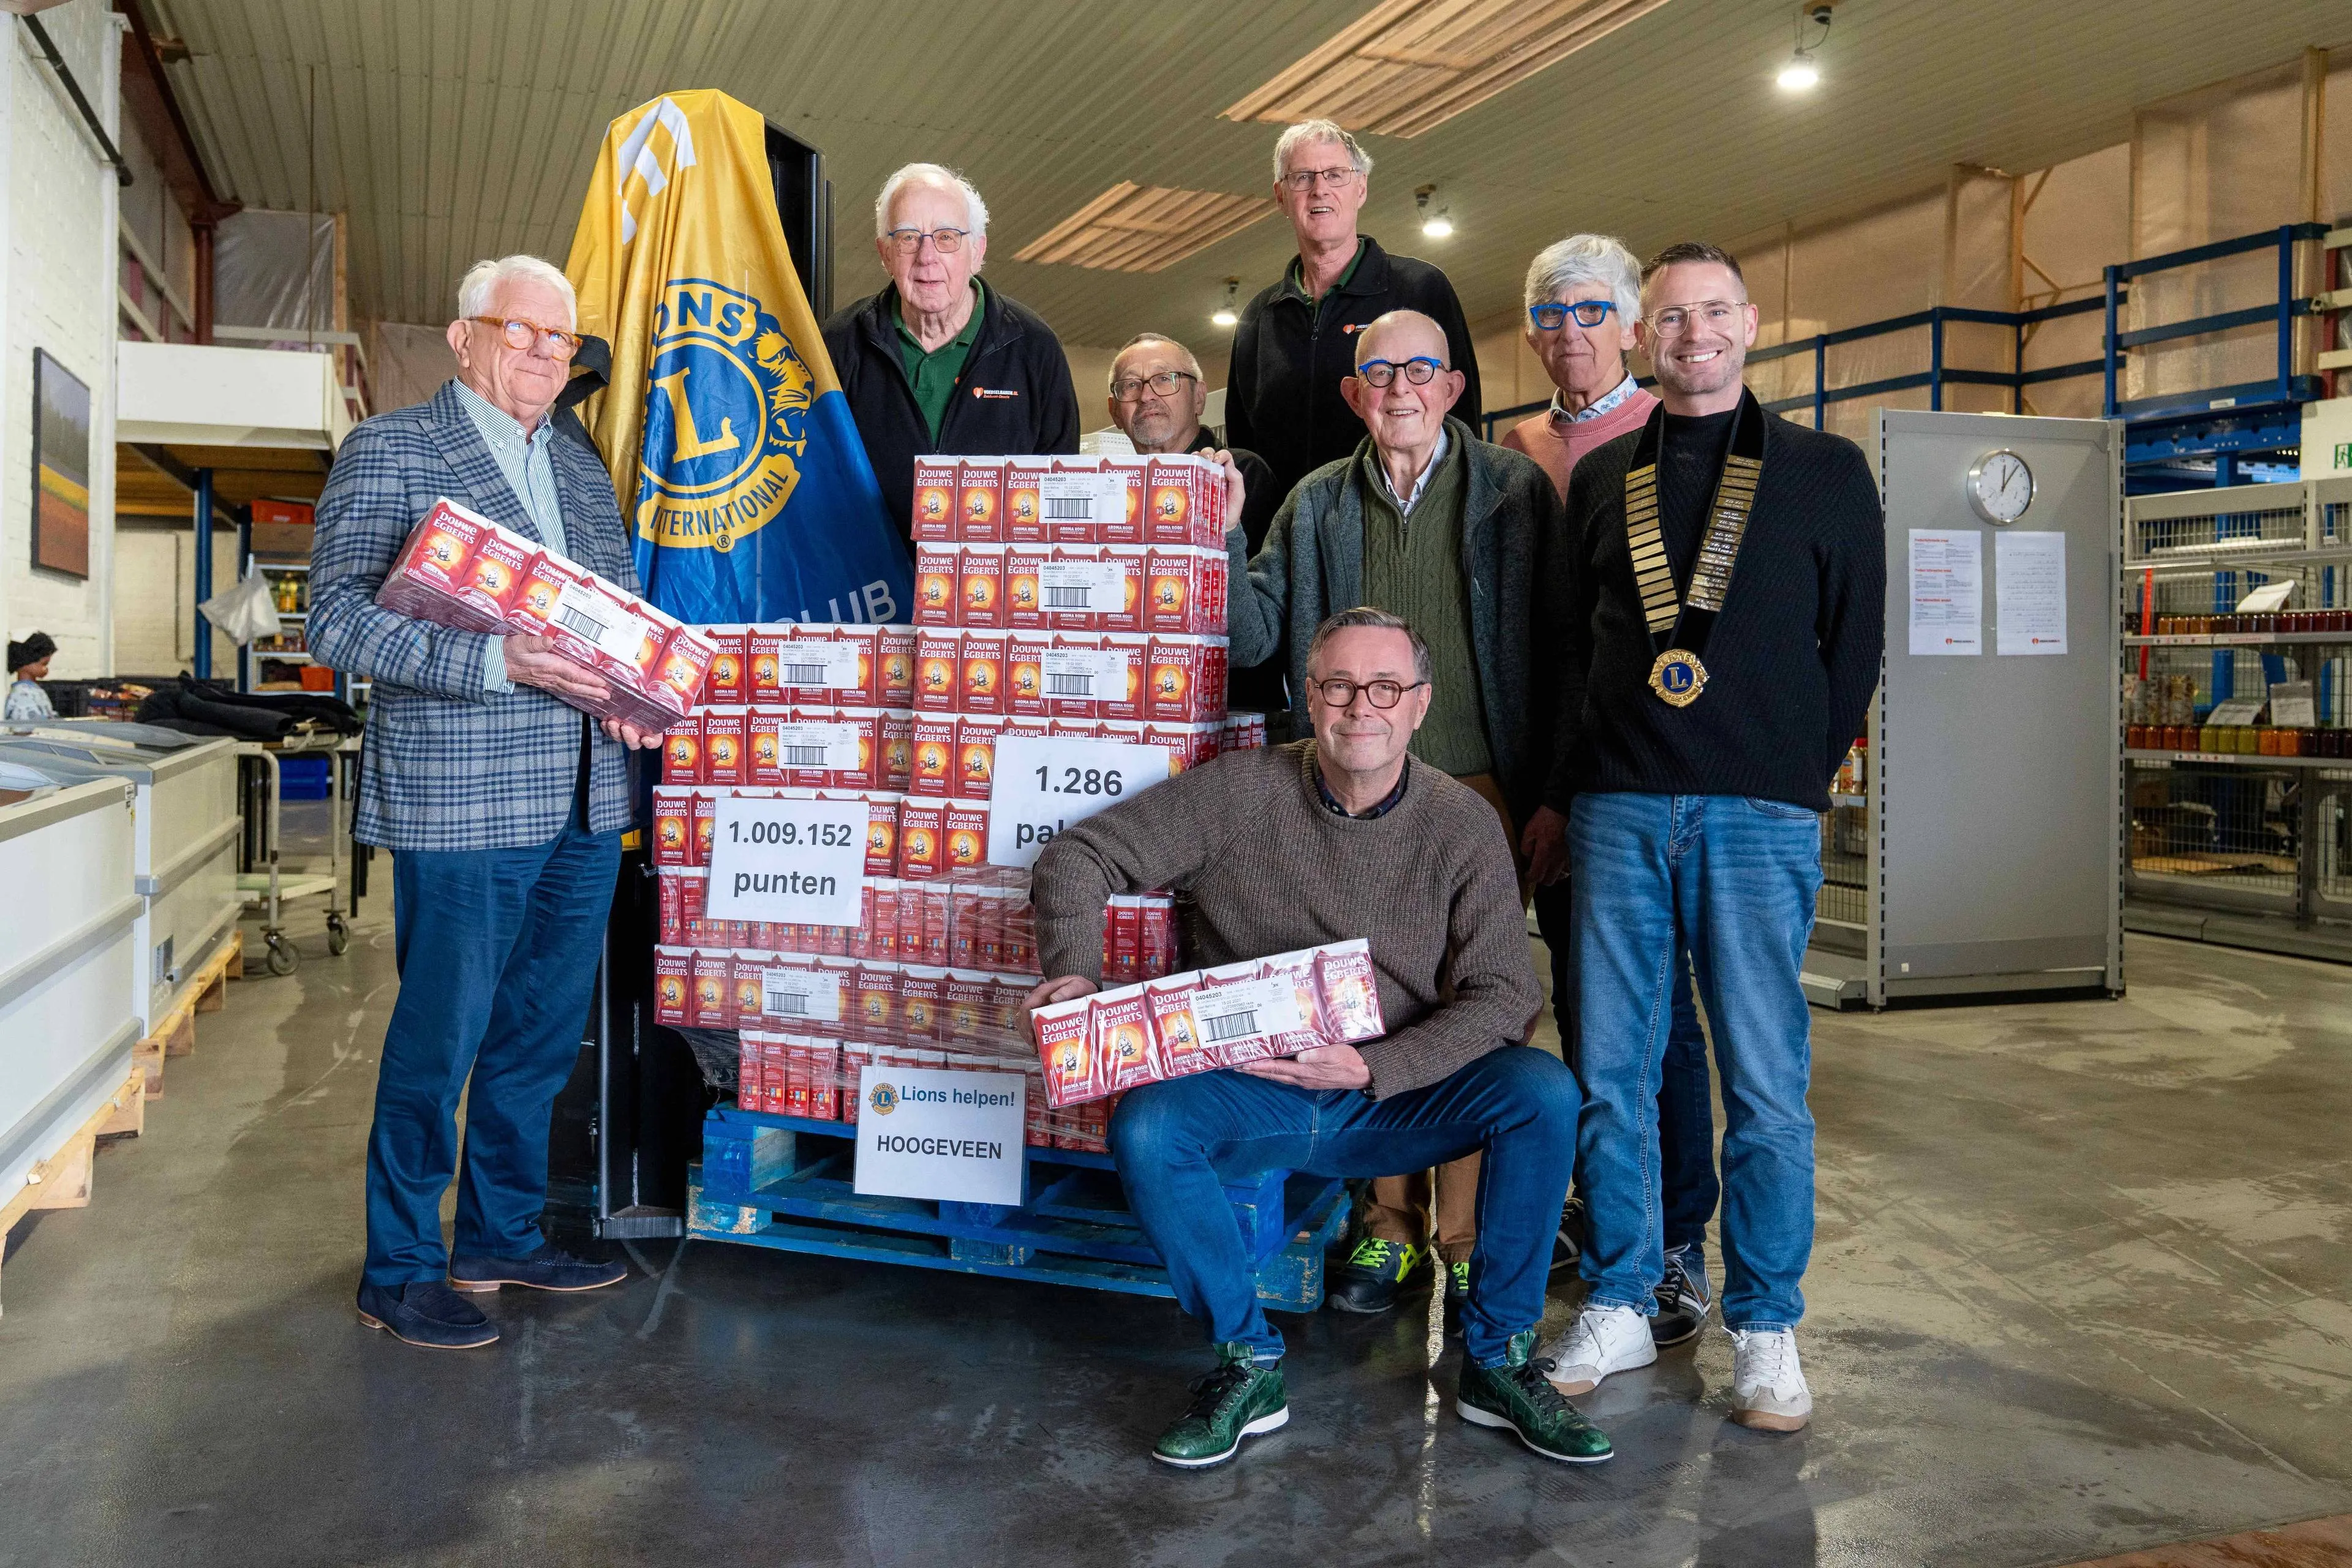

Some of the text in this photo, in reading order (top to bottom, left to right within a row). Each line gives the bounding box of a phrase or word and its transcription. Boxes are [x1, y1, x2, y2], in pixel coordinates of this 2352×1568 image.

[656, 292, 747, 337] ONS
[655, 367, 740, 464] L
[1152, 478, 1190, 486] EGBERTS
[433, 520, 475, 545] EGBERTS
[482, 546, 522, 571] EGBERTS
[532, 569, 564, 589] EGBERT
[569, 584, 592, 599] 04045203
[671, 643, 706, 668] EGBERTS
[881, 645, 916, 654] EGBERTS
[920, 649, 956, 658] EGBERTS
[964, 650, 1000, 659] EGBERTS
[1152, 655, 1190, 665] EGBERTS
[1668, 667, 1688, 689] L
[883, 730, 912, 739] EGBERT
[915, 733, 951, 742] EGBERTS
[1036, 765, 1123, 796] 1.286
[903, 819, 938, 829] EGBERTS
[947, 821, 983, 831] EGBERTS
[729, 821, 851, 847] 1.009.152
[734, 870, 836, 898] punten
[657, 967, 687, 976] EGBERTS
[695, 968, 726, 977] EGBERTS
[734, 971, 762, 980] EGBERT
[1324, 966, 1368, 981] EGBERTS
[859, 981, 894, 991] EGBERTS
[903, 988, 938, 999] EGBERTS
[948, 992, 984, 1002] EGBERTS
[1155, 990, 1189, 1006] DOUW
[1196, 992, 1222, 1001] 04045203
[993, 995, 1024, 1006] EGBERT
[1155, 1000, 1192, 1017] EGBERT
[1042, 1026, 1087, 1045] EGBERTS
[902, 1085, 1014, 1108] Lions helpen!
[877, 1135, 1001, 1159] HOOGEVEEN
